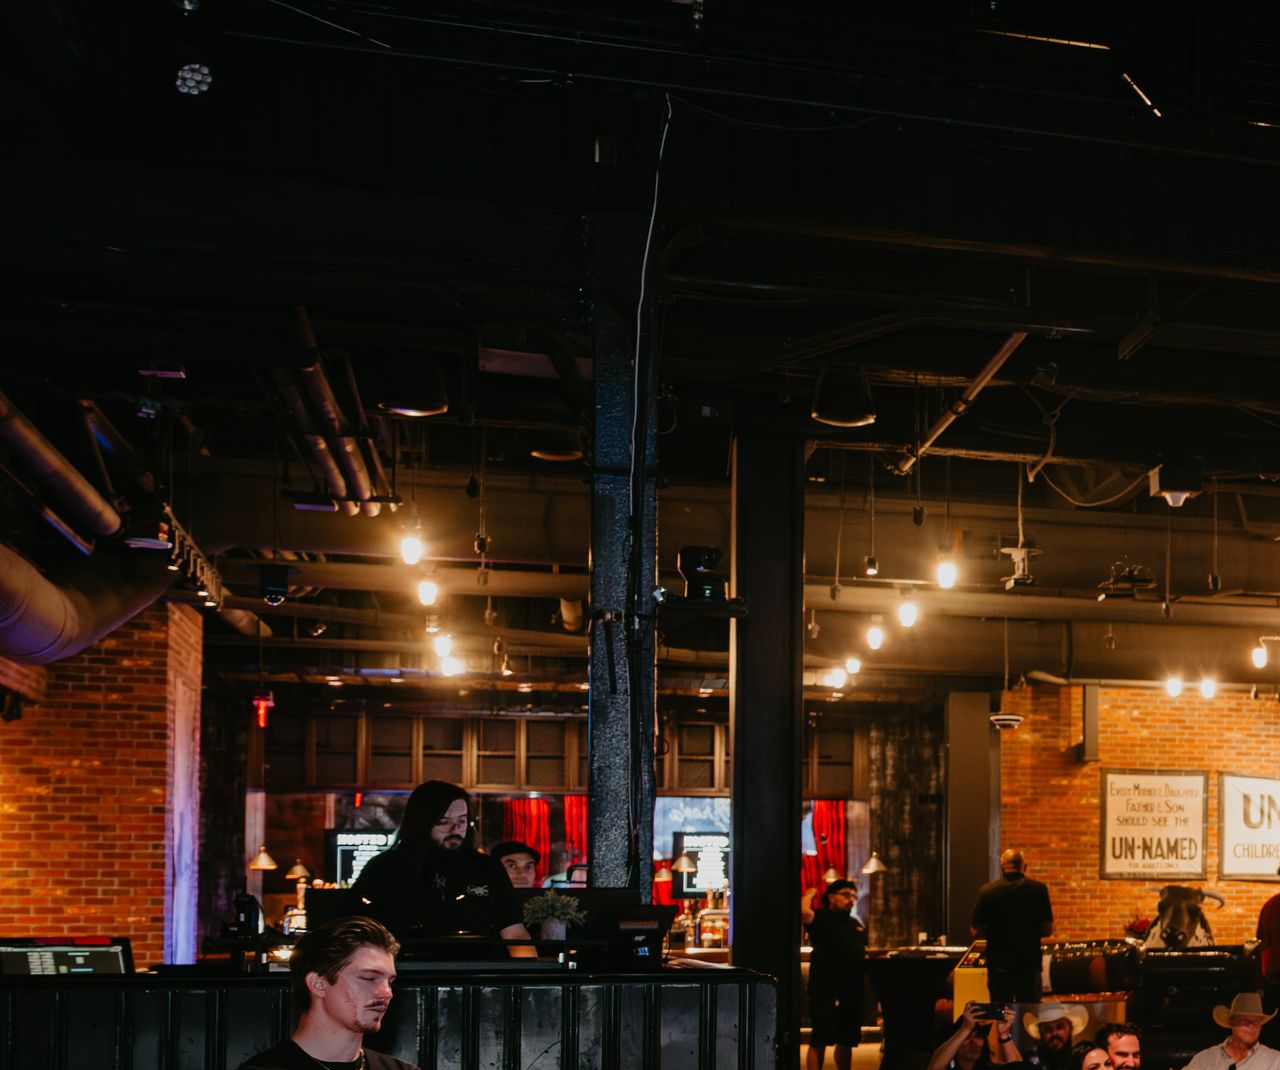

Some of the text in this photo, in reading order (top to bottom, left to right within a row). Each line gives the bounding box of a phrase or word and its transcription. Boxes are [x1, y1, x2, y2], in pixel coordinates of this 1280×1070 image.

[1116, 815, 1191, 827] SHOULD SEE THE
[1112, 836, 1198, 860] UN-NAMED
